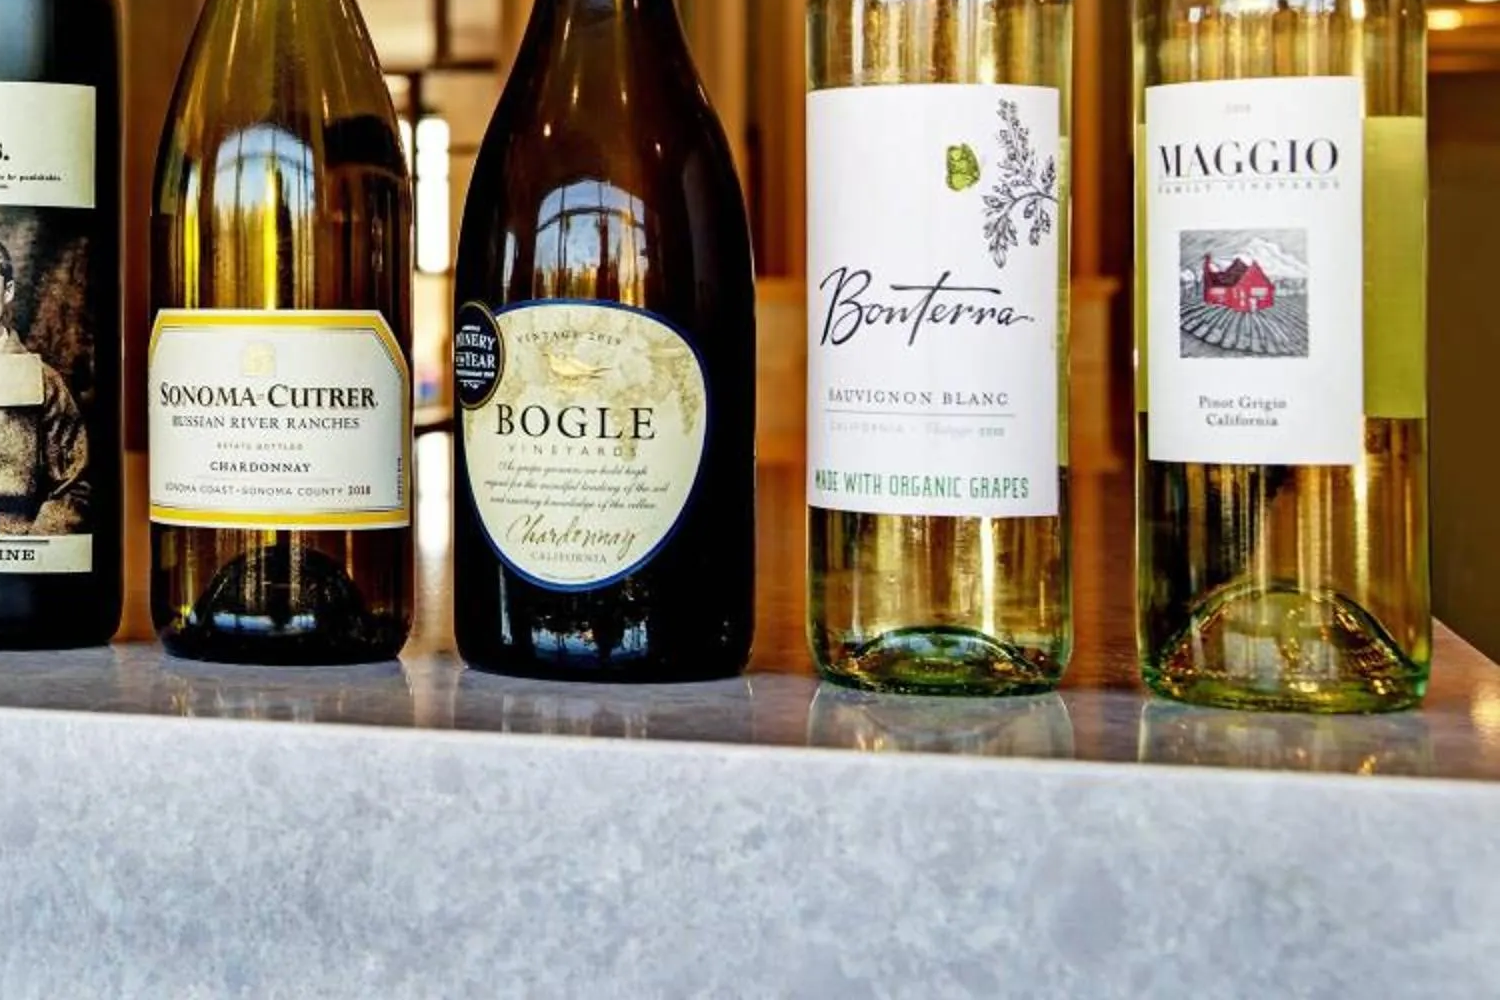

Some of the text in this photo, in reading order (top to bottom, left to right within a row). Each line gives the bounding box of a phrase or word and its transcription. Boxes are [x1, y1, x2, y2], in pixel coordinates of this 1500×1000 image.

[1158, 138, 1340, 178] MAGGIO
[819, 266, 1035, 347] Bonterra
[828, 387, 1010, 407] SAUVIGNON BLANC
[1199, 394, 1288, 412] Pinot Grigio
[172, 414, 361, 431] RUSSIAN RIVER RANCHES
[495, 403, 657, 441] BOGLE
[1205, 412, 1279, 428] California
[508, 445, 639, 458] VINEYARDS
[209, 460, 312, 474] CHARDONNAY
[164, 481, 198, 494] SONOMA
[199, 484, 235, 495] COAST
[297, 487, 343, 497] COUNTY
[815, 469, 1030, 501] MADE WITH ORGANIC GRAPES
[505, 512, 637, 562] Chardonnay
